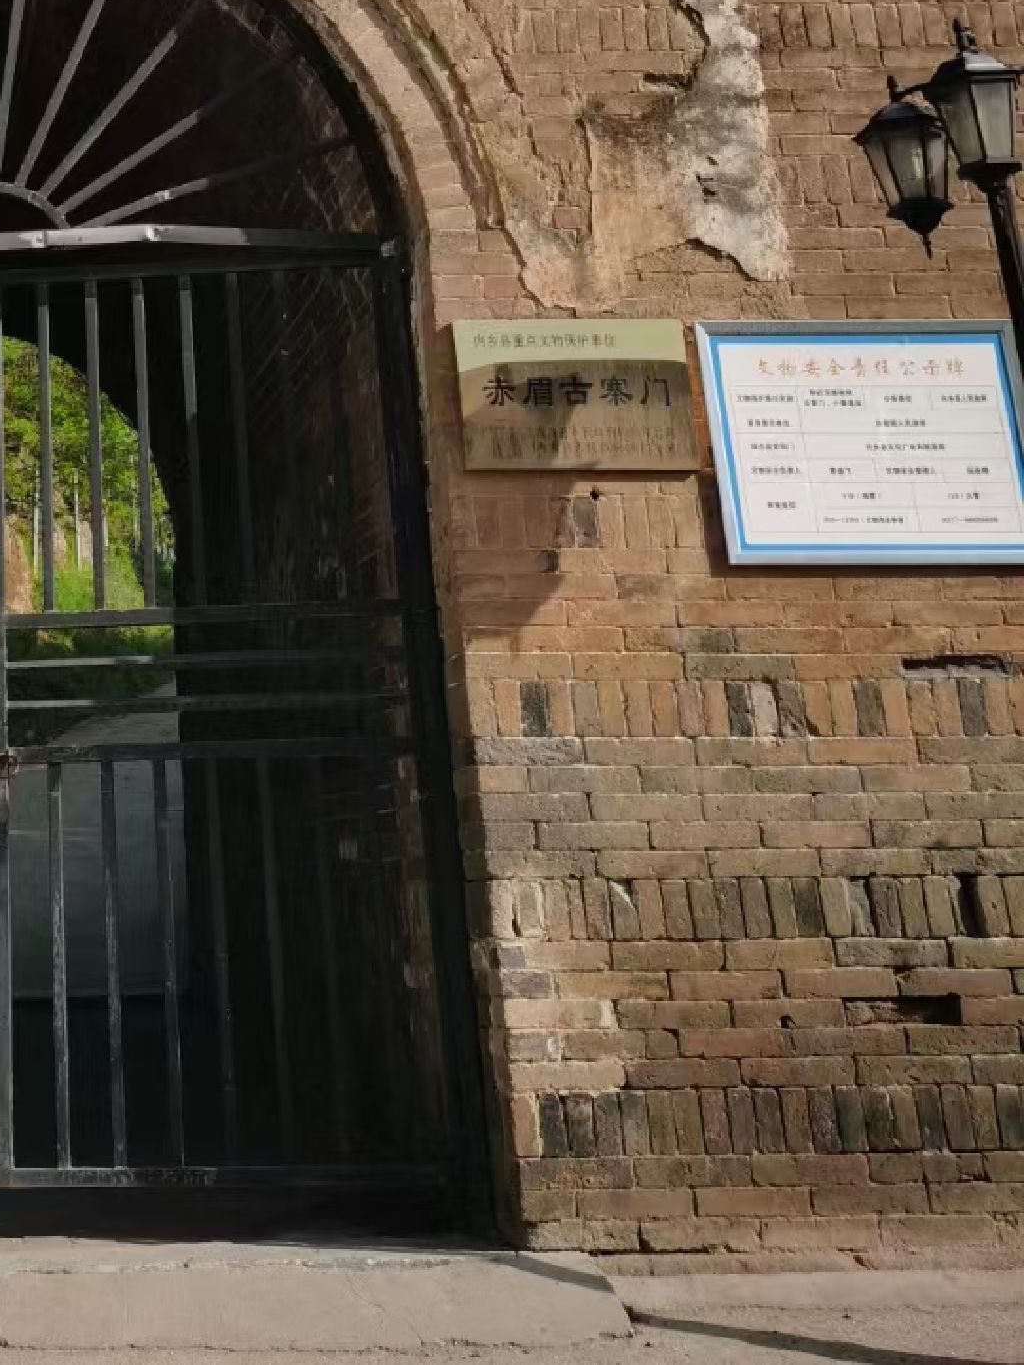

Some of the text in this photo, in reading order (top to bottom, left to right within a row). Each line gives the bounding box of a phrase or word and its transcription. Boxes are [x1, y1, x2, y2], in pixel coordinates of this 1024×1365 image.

[757, 357, 965, 378] 文物安全责任公示牌
[481, 374, 672, 407] 赤眉古寨门
